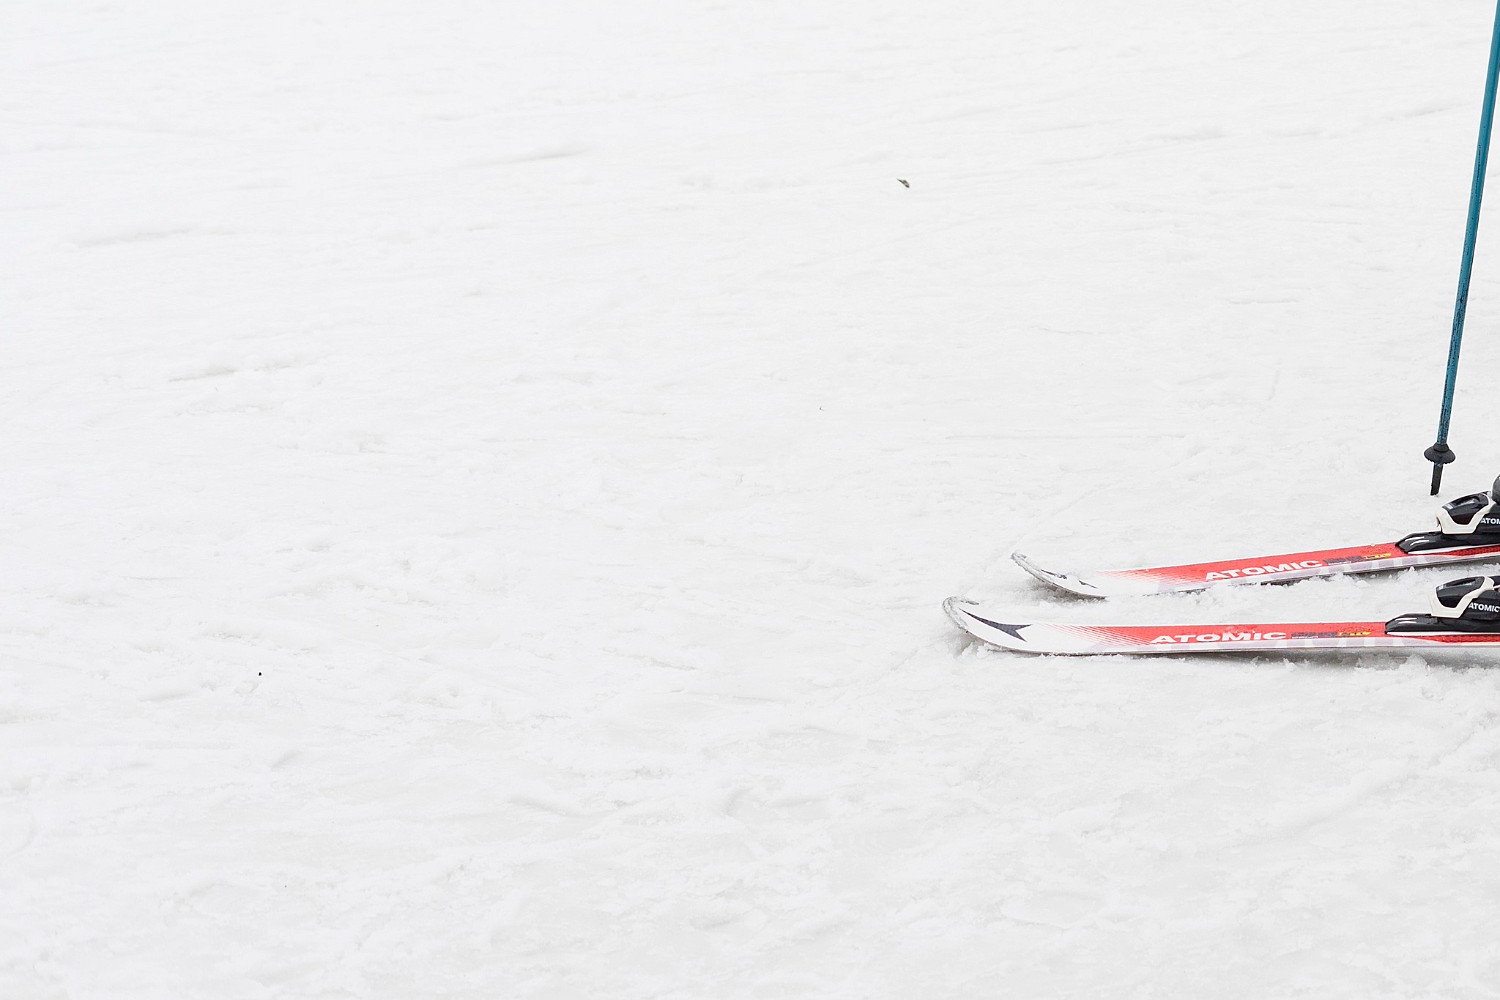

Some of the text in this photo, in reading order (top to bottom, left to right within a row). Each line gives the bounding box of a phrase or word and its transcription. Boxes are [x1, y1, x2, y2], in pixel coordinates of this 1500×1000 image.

[1205, 560, 1323, 581] ATOMIC
[1468, 602, 1500, 613] ATOMIC
[1150, 632, 1287, 643] ATOMIC
